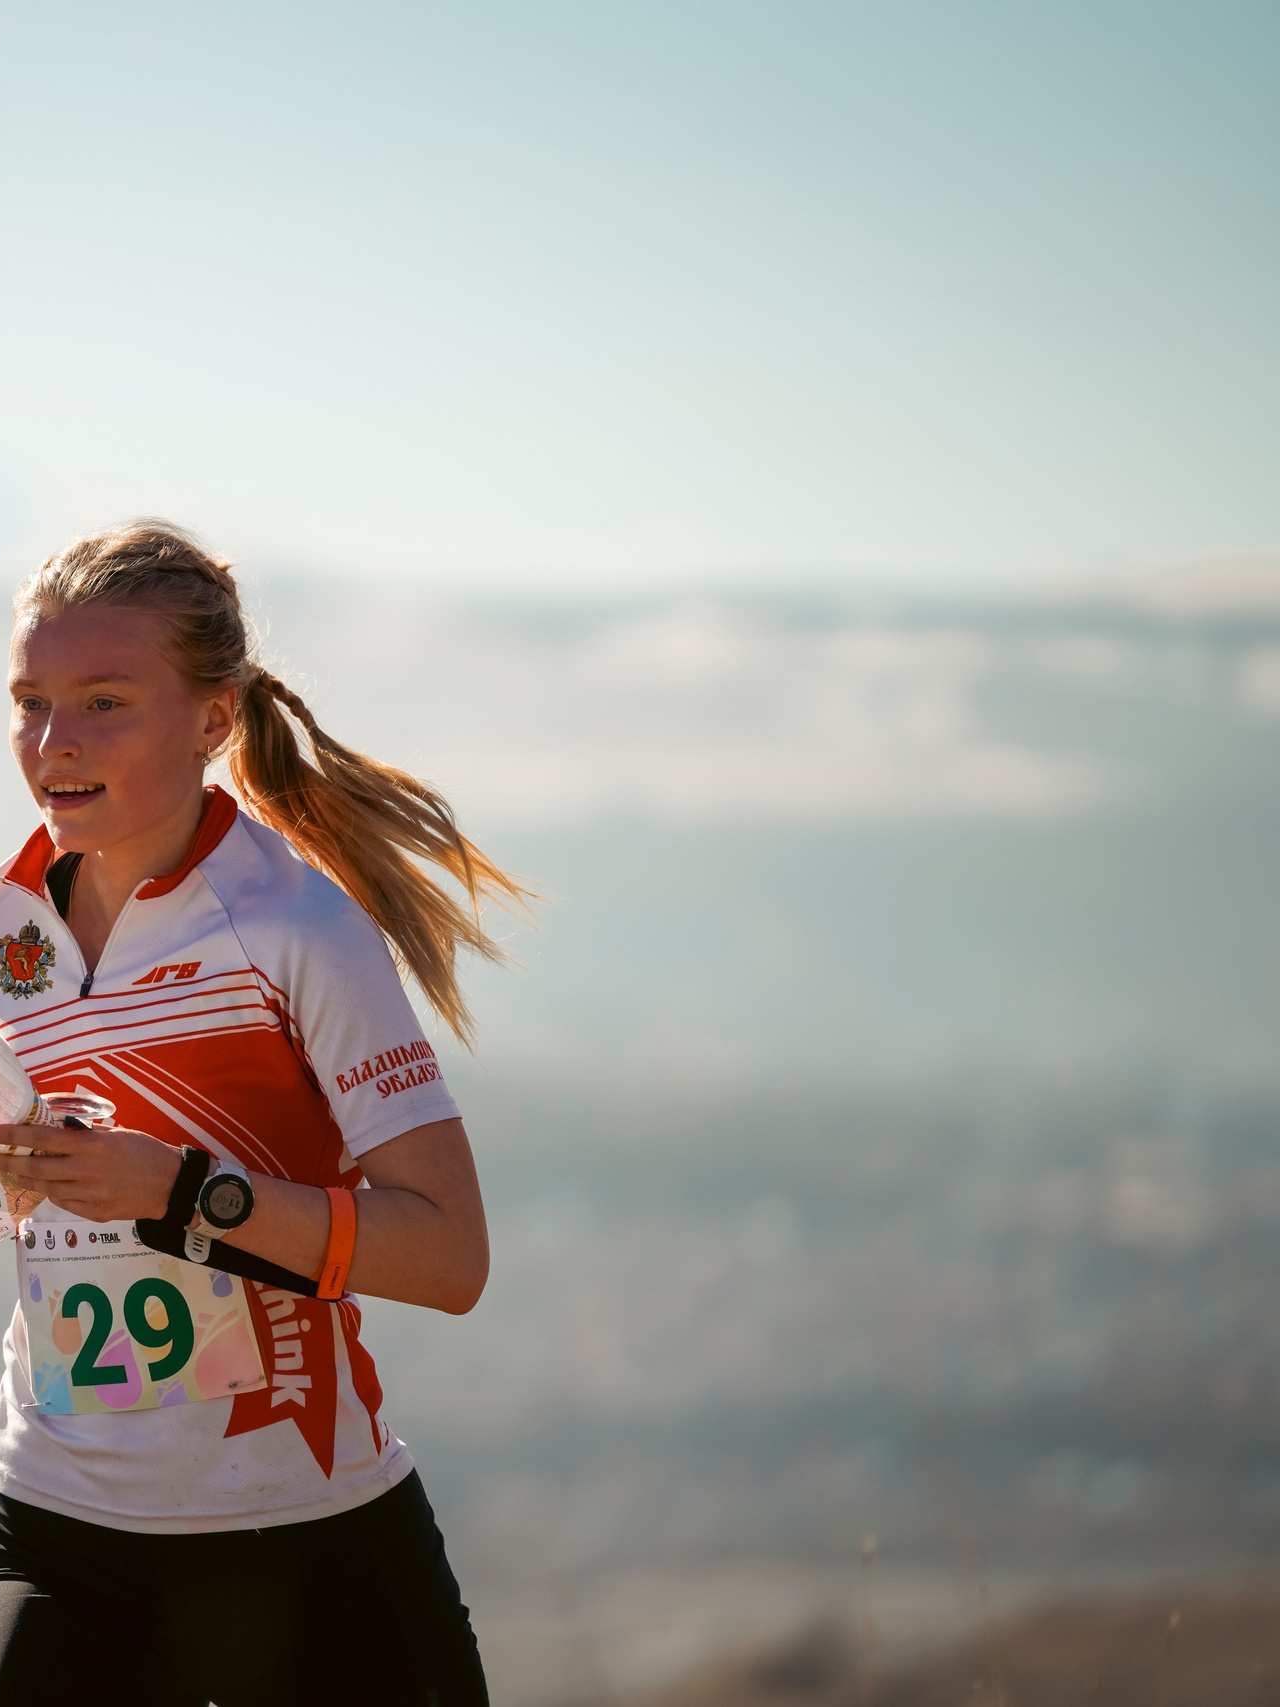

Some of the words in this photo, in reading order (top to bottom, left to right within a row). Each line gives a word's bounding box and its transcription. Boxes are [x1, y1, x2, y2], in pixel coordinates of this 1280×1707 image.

[376, 1062, 443, 1099] ОБЛАСТ
[62, 1278, 195, 1387] 29
[253, 1281, 312, 1409] hink
